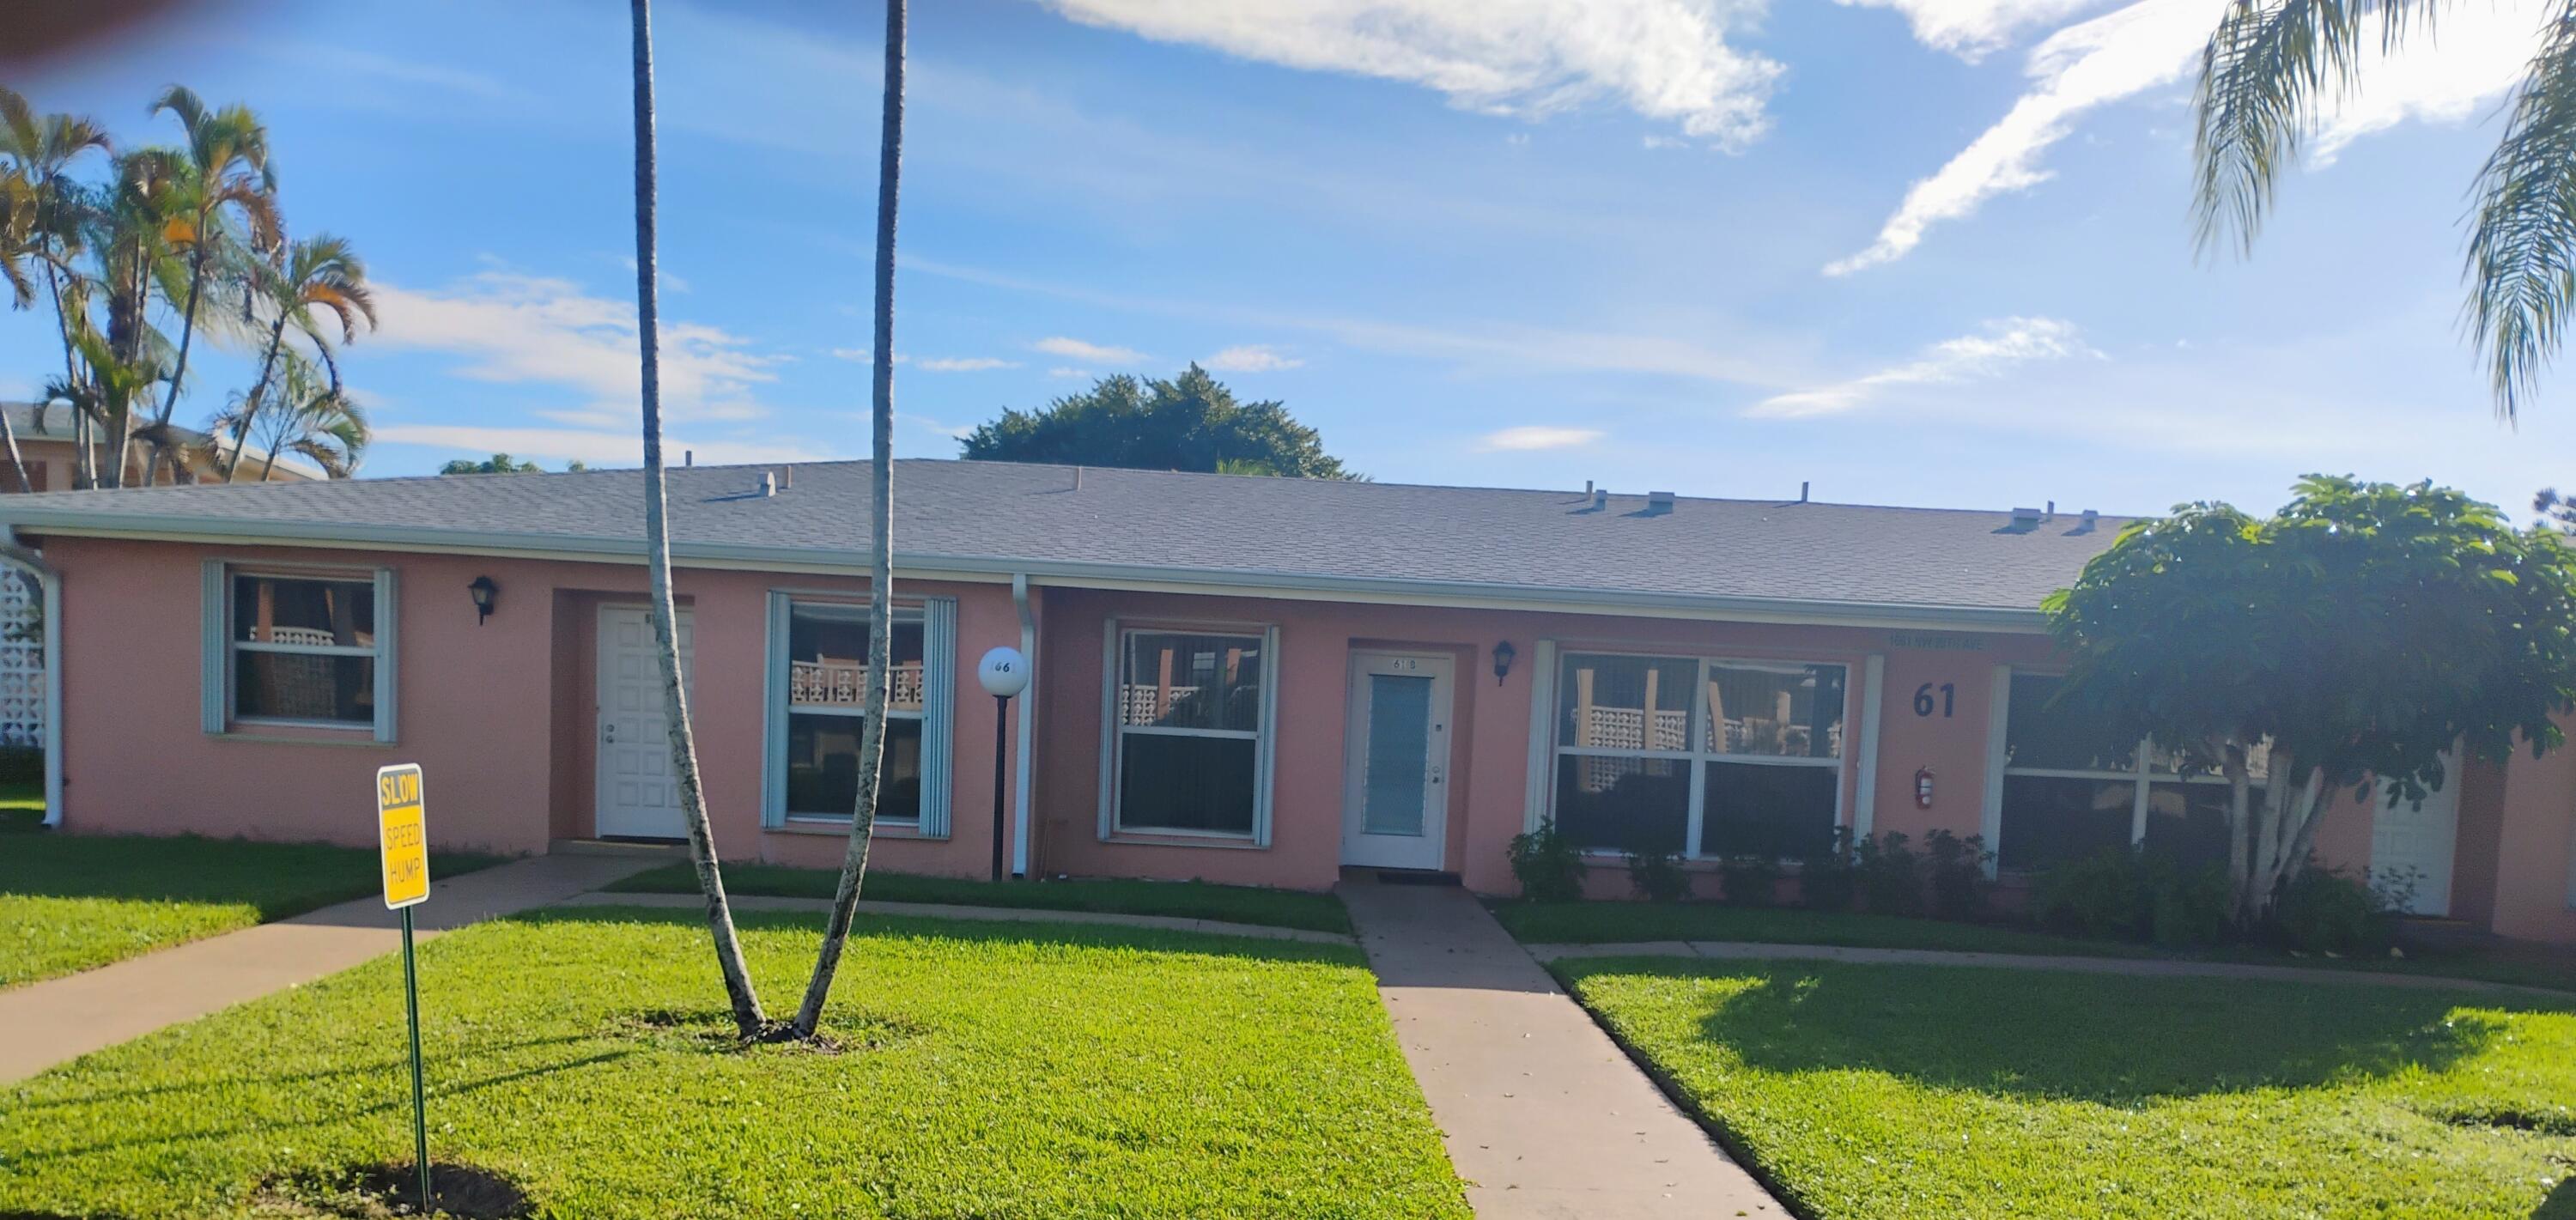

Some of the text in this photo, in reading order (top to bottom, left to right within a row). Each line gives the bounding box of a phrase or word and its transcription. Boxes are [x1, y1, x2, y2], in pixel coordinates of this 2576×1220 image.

[1914, 683, 1954, 718] 61
[381, 773, 419, 805] SLOW
[386, 823, 420, 850] SPEED
[390, 858, 420, 884] HUMP
